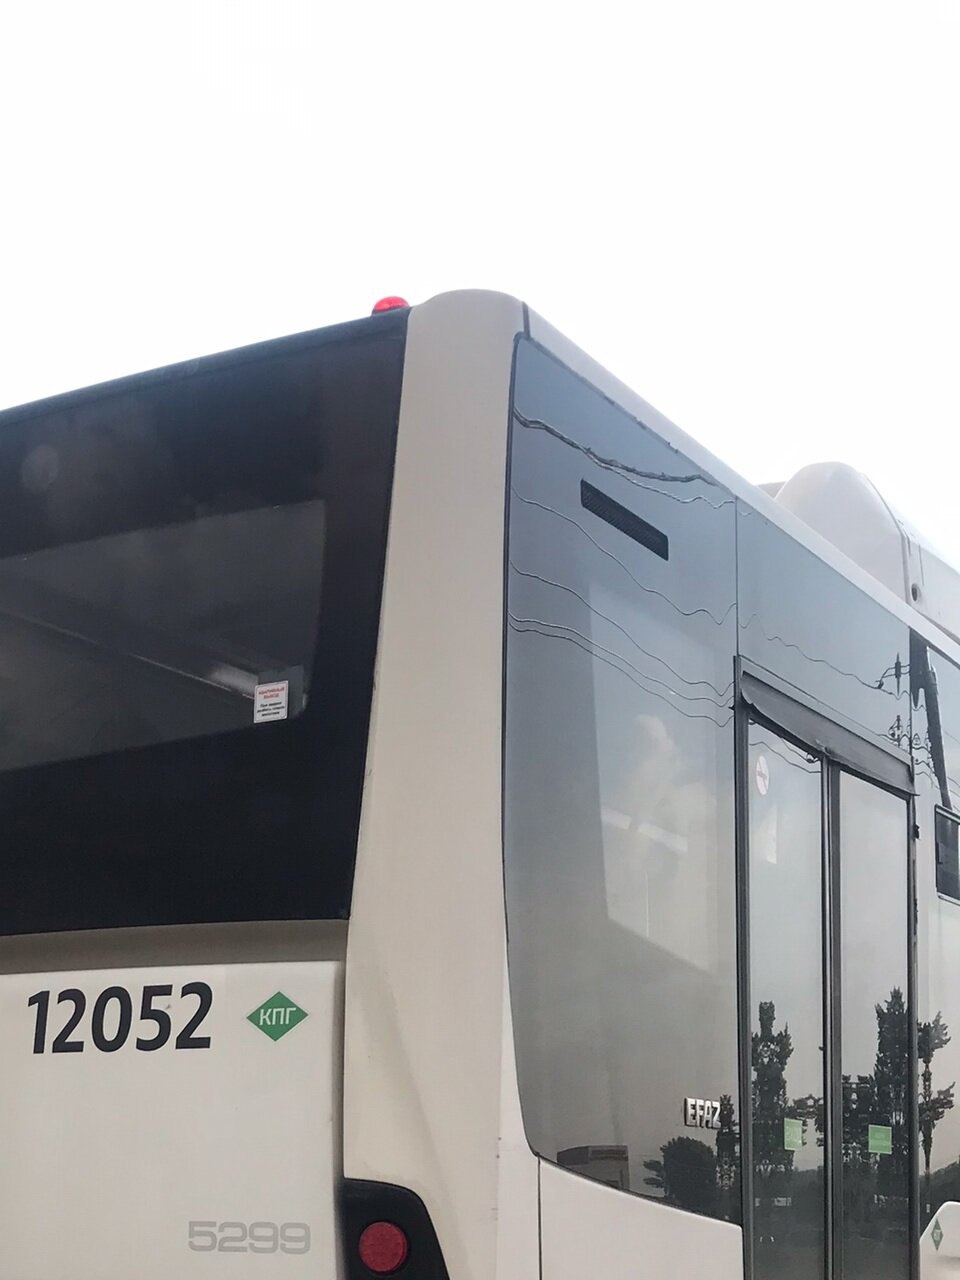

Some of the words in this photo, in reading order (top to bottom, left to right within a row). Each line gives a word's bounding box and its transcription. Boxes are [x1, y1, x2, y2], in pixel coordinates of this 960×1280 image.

[27, 981, 214, 1055] 12052
[258, 1006, 297, 1026] КПГ
[187, 1220, 312, 1255] 5299
